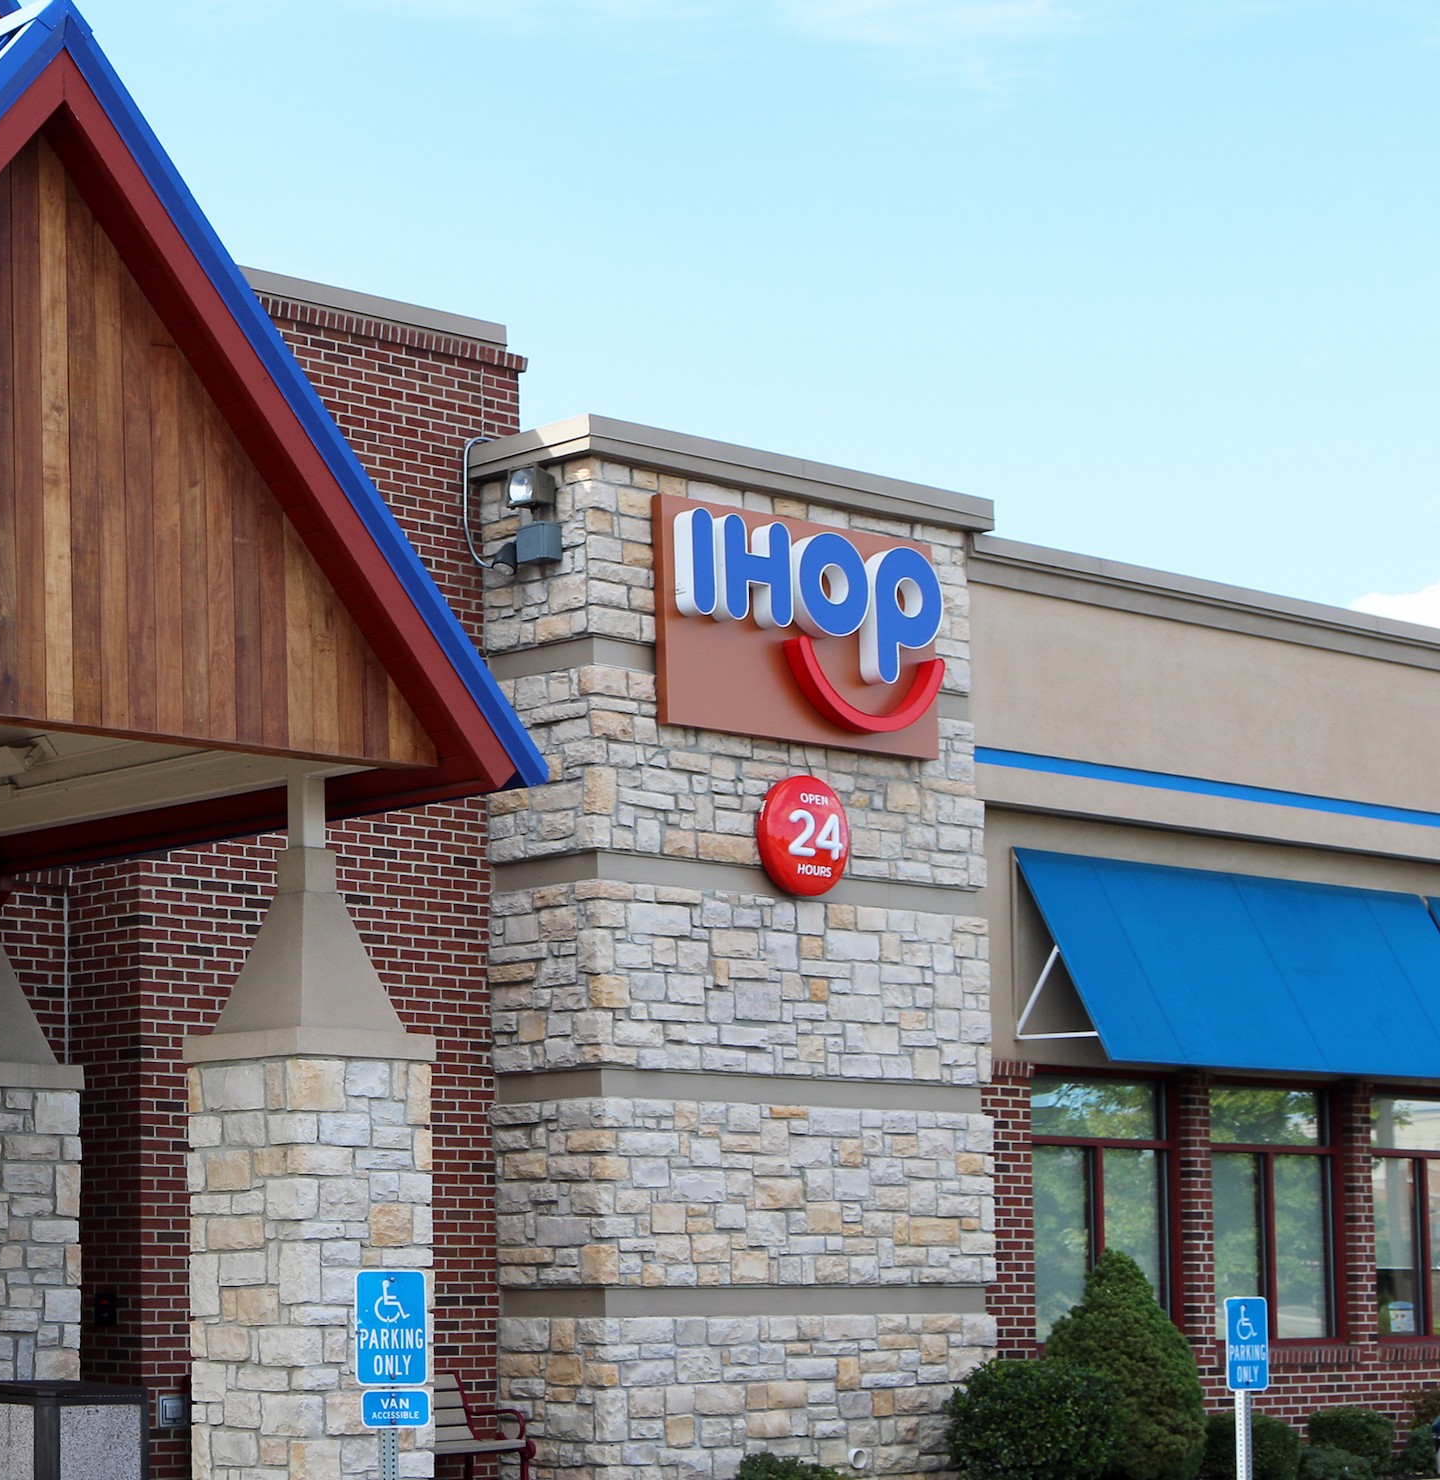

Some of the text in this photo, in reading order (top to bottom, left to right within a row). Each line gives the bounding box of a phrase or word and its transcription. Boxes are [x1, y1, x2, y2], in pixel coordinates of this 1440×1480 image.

[674, 507, 943, 685] IHOP
[800, 792, 829, 806] OPEN
[788, 809, 844, 861] 24
[797, 863, 832, 878] HOURS
[360, 1328, 424, 1350] PARKING
[1229, 1344, 1266, 1361] PARKING
[373, 1354, 412, 1376] ONLY
[1236, 1365, 1259, 1382] ONLY
[380, 1398, 410, 1409] VAN
[371, 1411, 420, 1420] ACCESSIBLE
